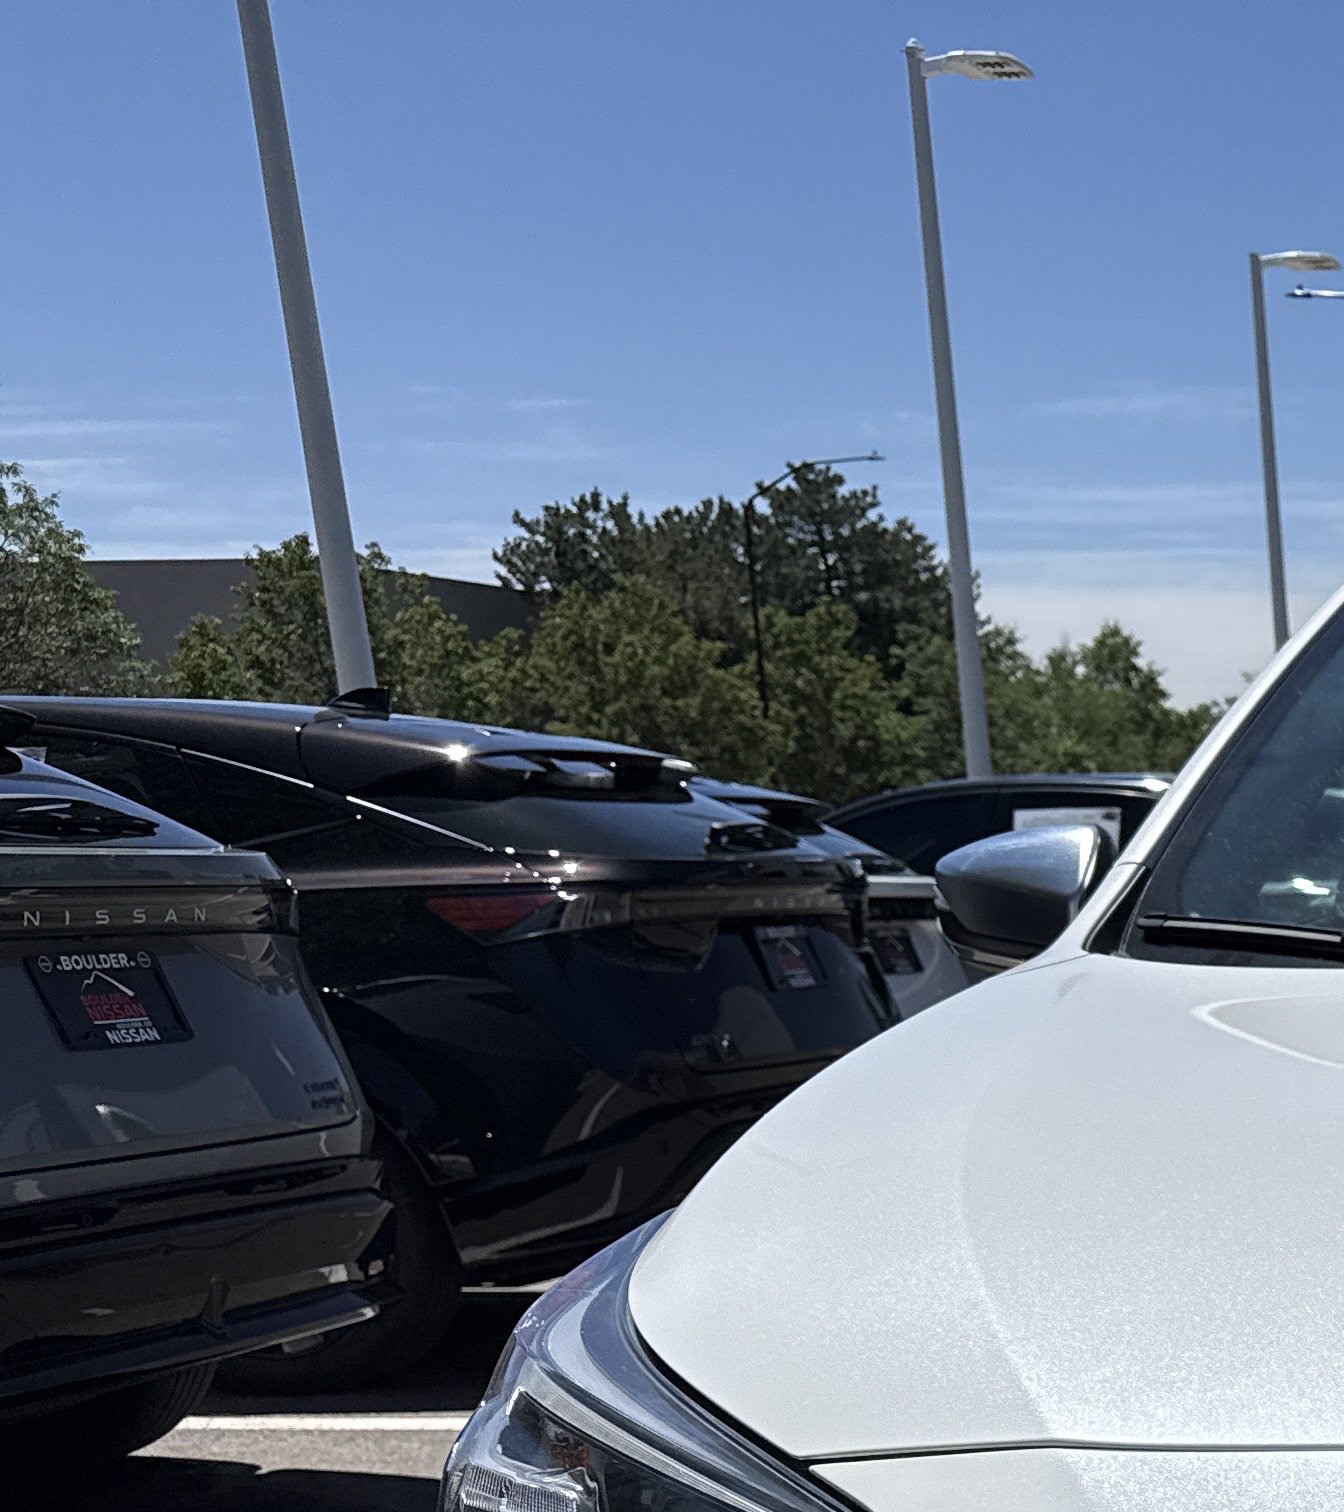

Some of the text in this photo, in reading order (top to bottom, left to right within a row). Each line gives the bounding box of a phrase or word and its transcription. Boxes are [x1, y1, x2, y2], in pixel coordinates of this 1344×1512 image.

[23, 907, 207, 927] NISSAN
[60, 952, 130, 971] BOULDER
[86, 1003, 147, 1021] NISSAN
[105, 1026, 161, 1045] NISSAN
